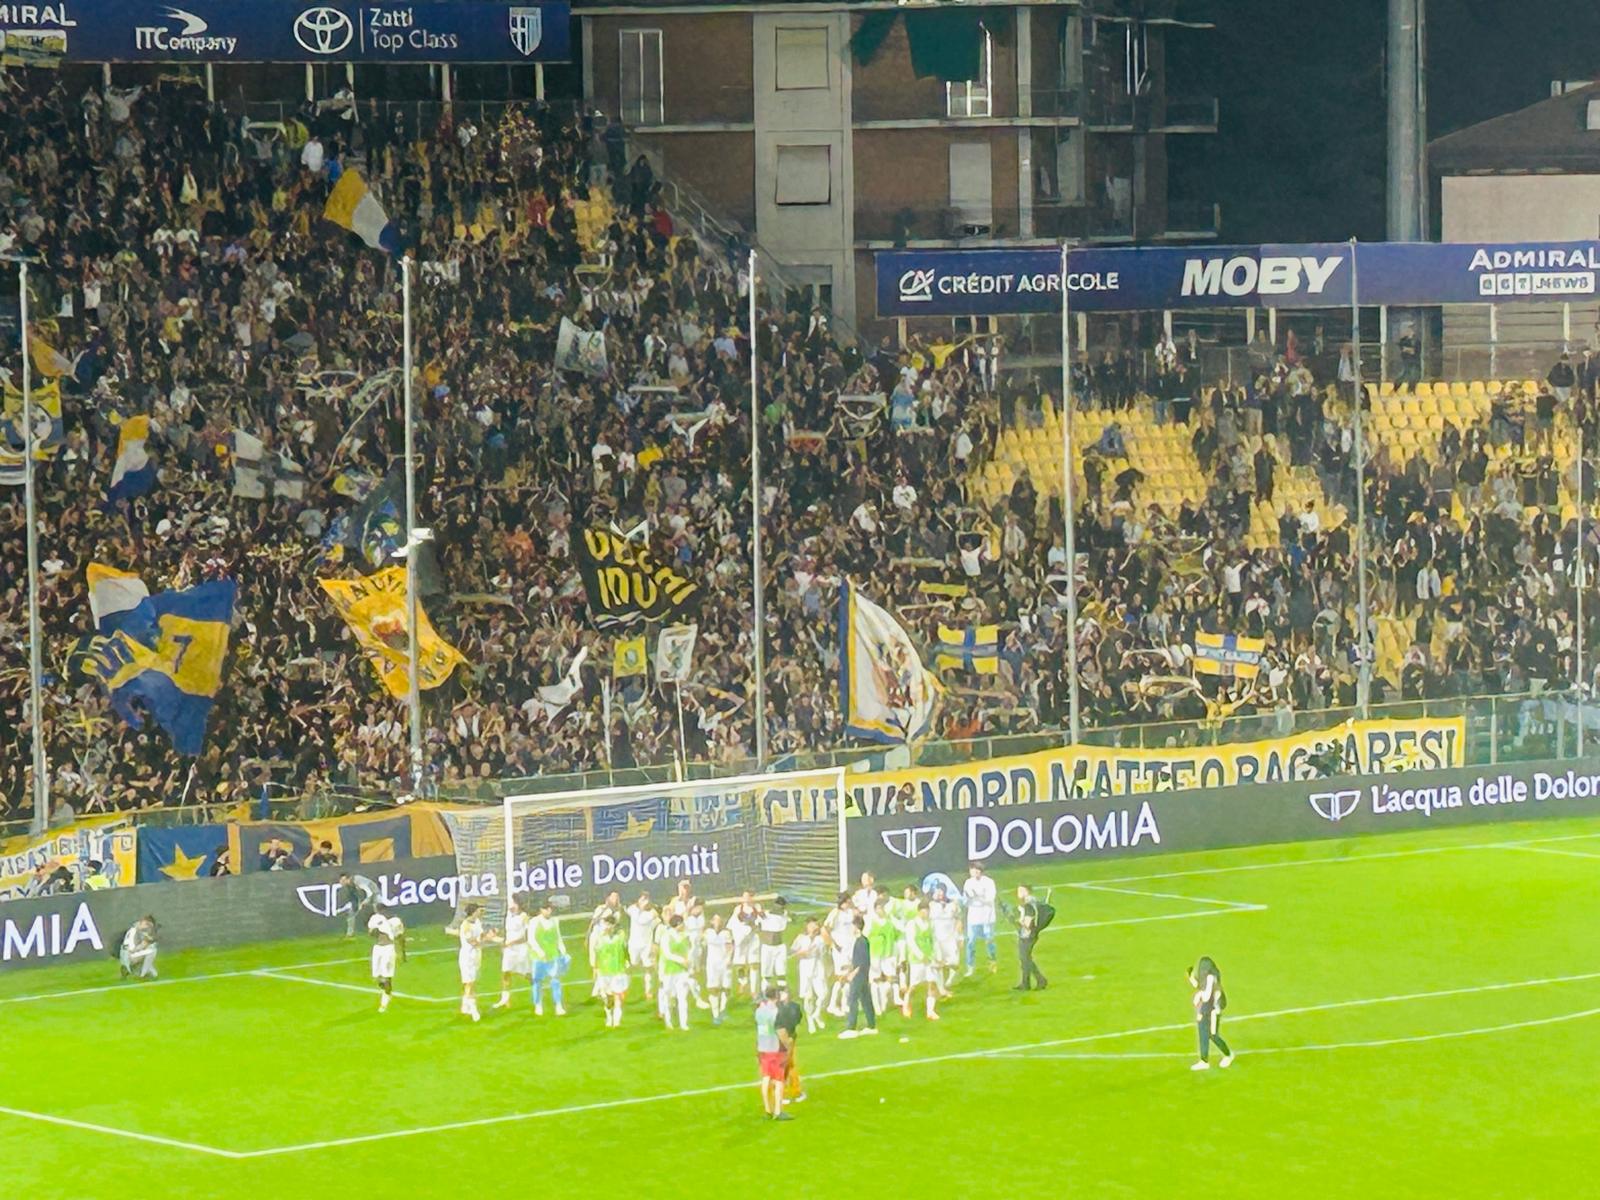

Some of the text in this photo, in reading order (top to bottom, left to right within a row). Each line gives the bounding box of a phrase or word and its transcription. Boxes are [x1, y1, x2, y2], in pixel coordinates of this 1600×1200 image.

[370, 7, 413, 28] Zatti
[371, 28, 458, 54] Top Class
[1181, 256, 1344, 296] MOBY
[1467, 246, 1600, 271] ADMIRAL
[938, 272, 1014, 294] CRÉDIT
[920, 767, 1037, 813] NORD
[1371, 783, 1463, 816] L'acqua
[1469, 774, 1528, 806] delle
[967, 801, 1161, 861] DOLOMIA
[379, 842, 721, 908] L'acqua delle Dolomiti
[3, 902, 103, 960] MIA
